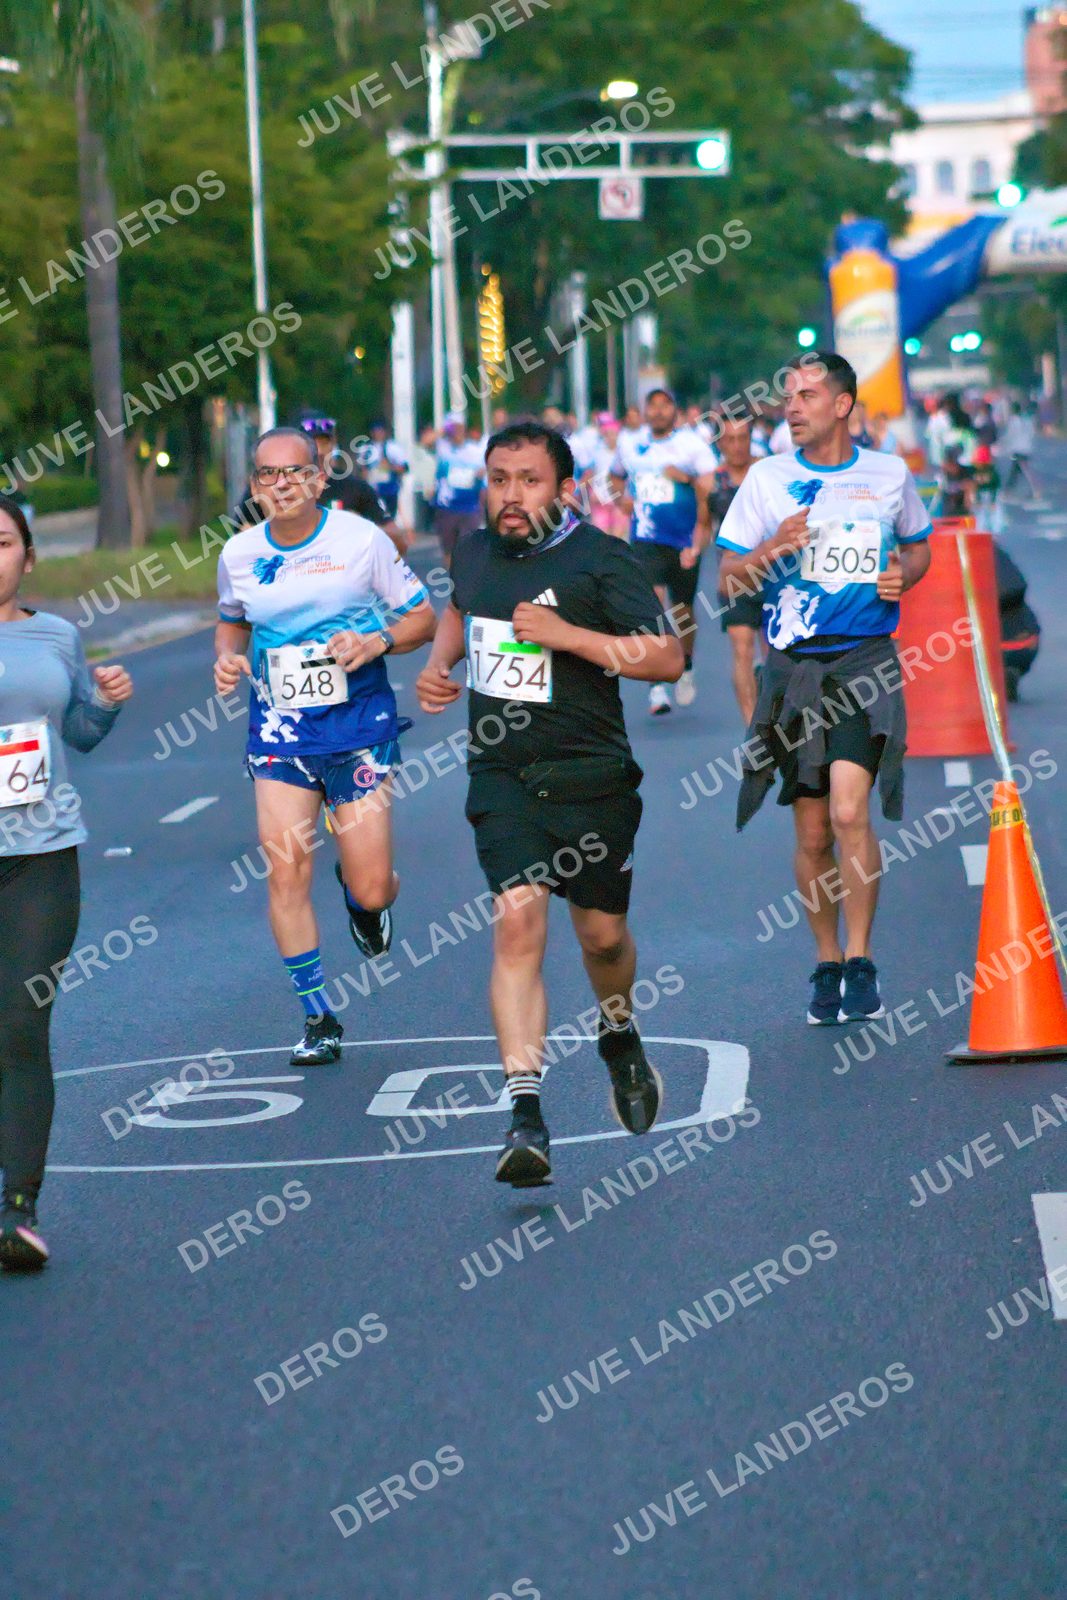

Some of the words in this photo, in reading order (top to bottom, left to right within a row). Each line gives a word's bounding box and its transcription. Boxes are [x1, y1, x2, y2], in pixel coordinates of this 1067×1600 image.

[807, 546, 878, 574] 1505
[282, 670, 334, 700] 548
[474, 650, 548, 691] 1754
